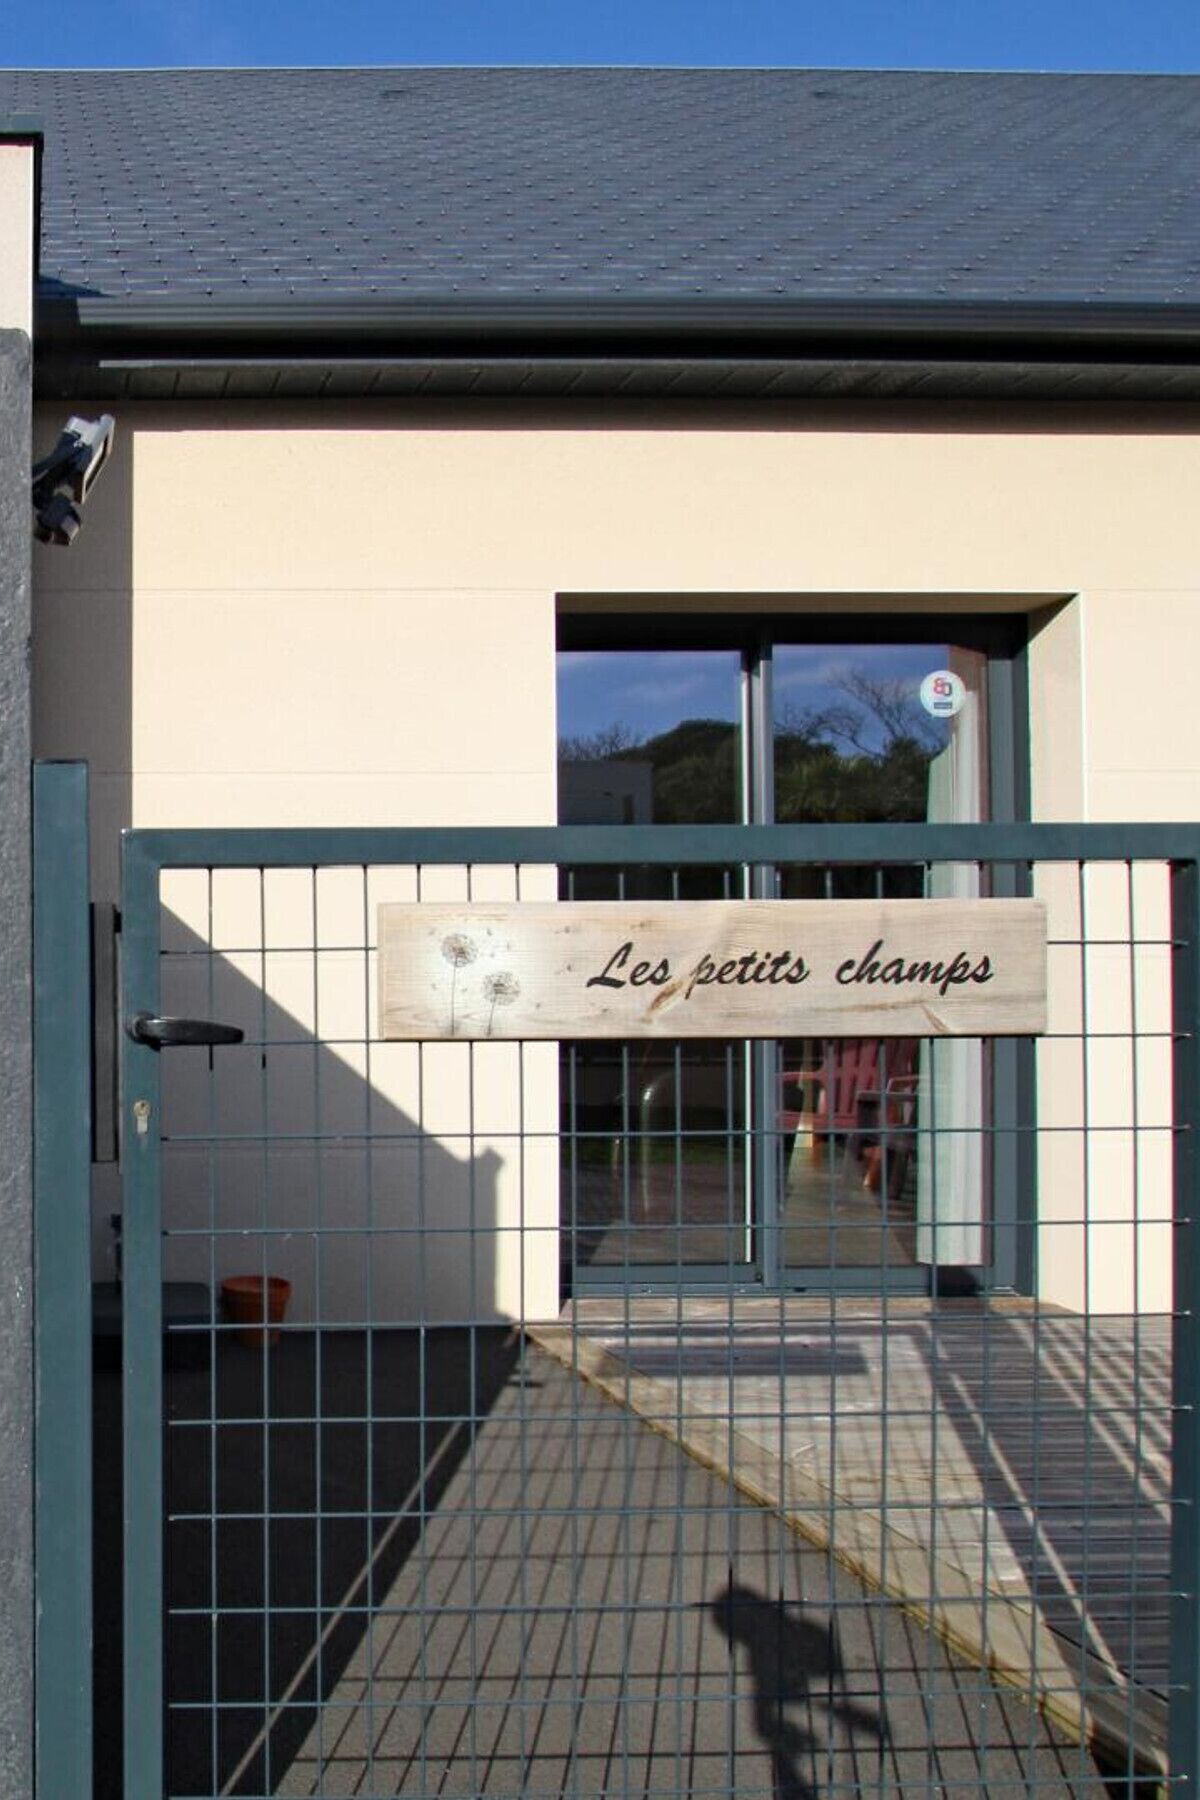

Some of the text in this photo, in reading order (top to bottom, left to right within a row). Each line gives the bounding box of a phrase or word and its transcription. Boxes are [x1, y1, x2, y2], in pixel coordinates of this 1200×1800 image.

[586, 939, 994, 999] Les petits champs
